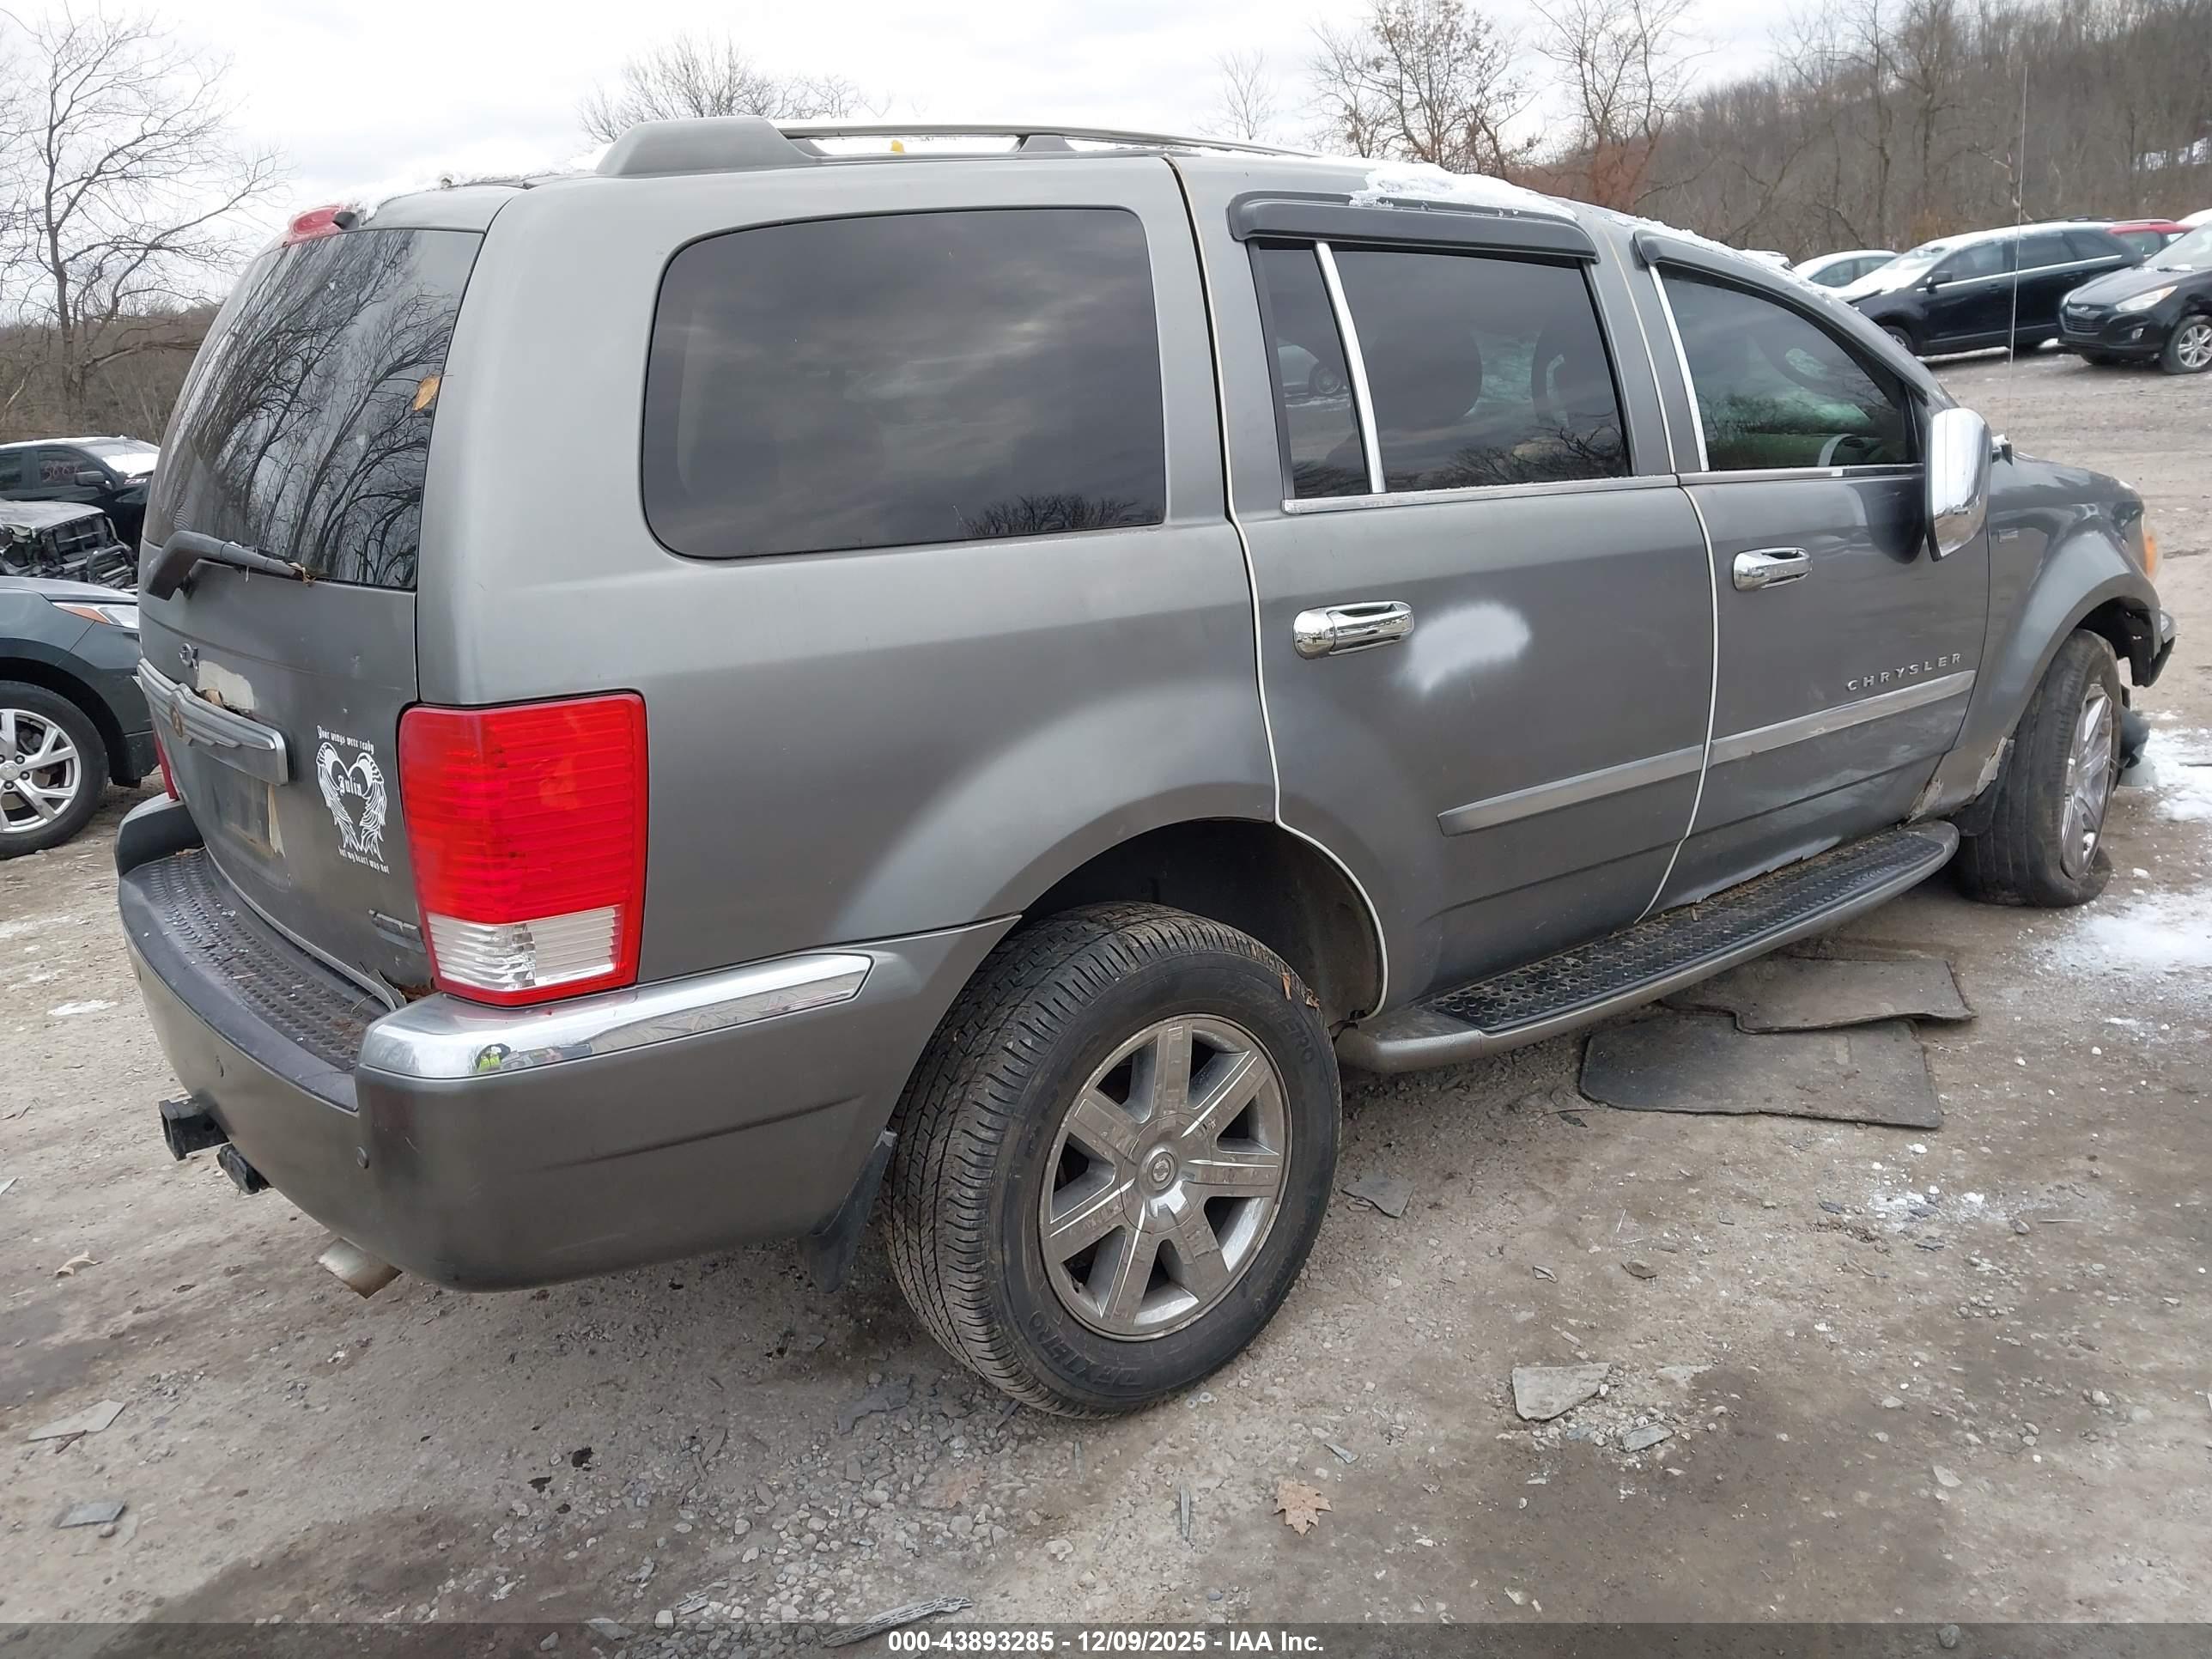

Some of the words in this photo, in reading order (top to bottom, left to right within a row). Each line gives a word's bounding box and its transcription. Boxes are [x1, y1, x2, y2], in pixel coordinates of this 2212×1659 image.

[1846, 653, 1962, 691] CHRYSLER
[316, 725, 331, 739] Your
[331, 730, 346, 745] wings
[347, 737, 359, 748] were
[359, 739, 375, 755] ready
[337, 775, 363, 797] Julia
[337, 845, 348, 858] but
[348, 850, 356, 863] my
[369, 858, 380, 870] was
[380, 863, 391, 875] not
